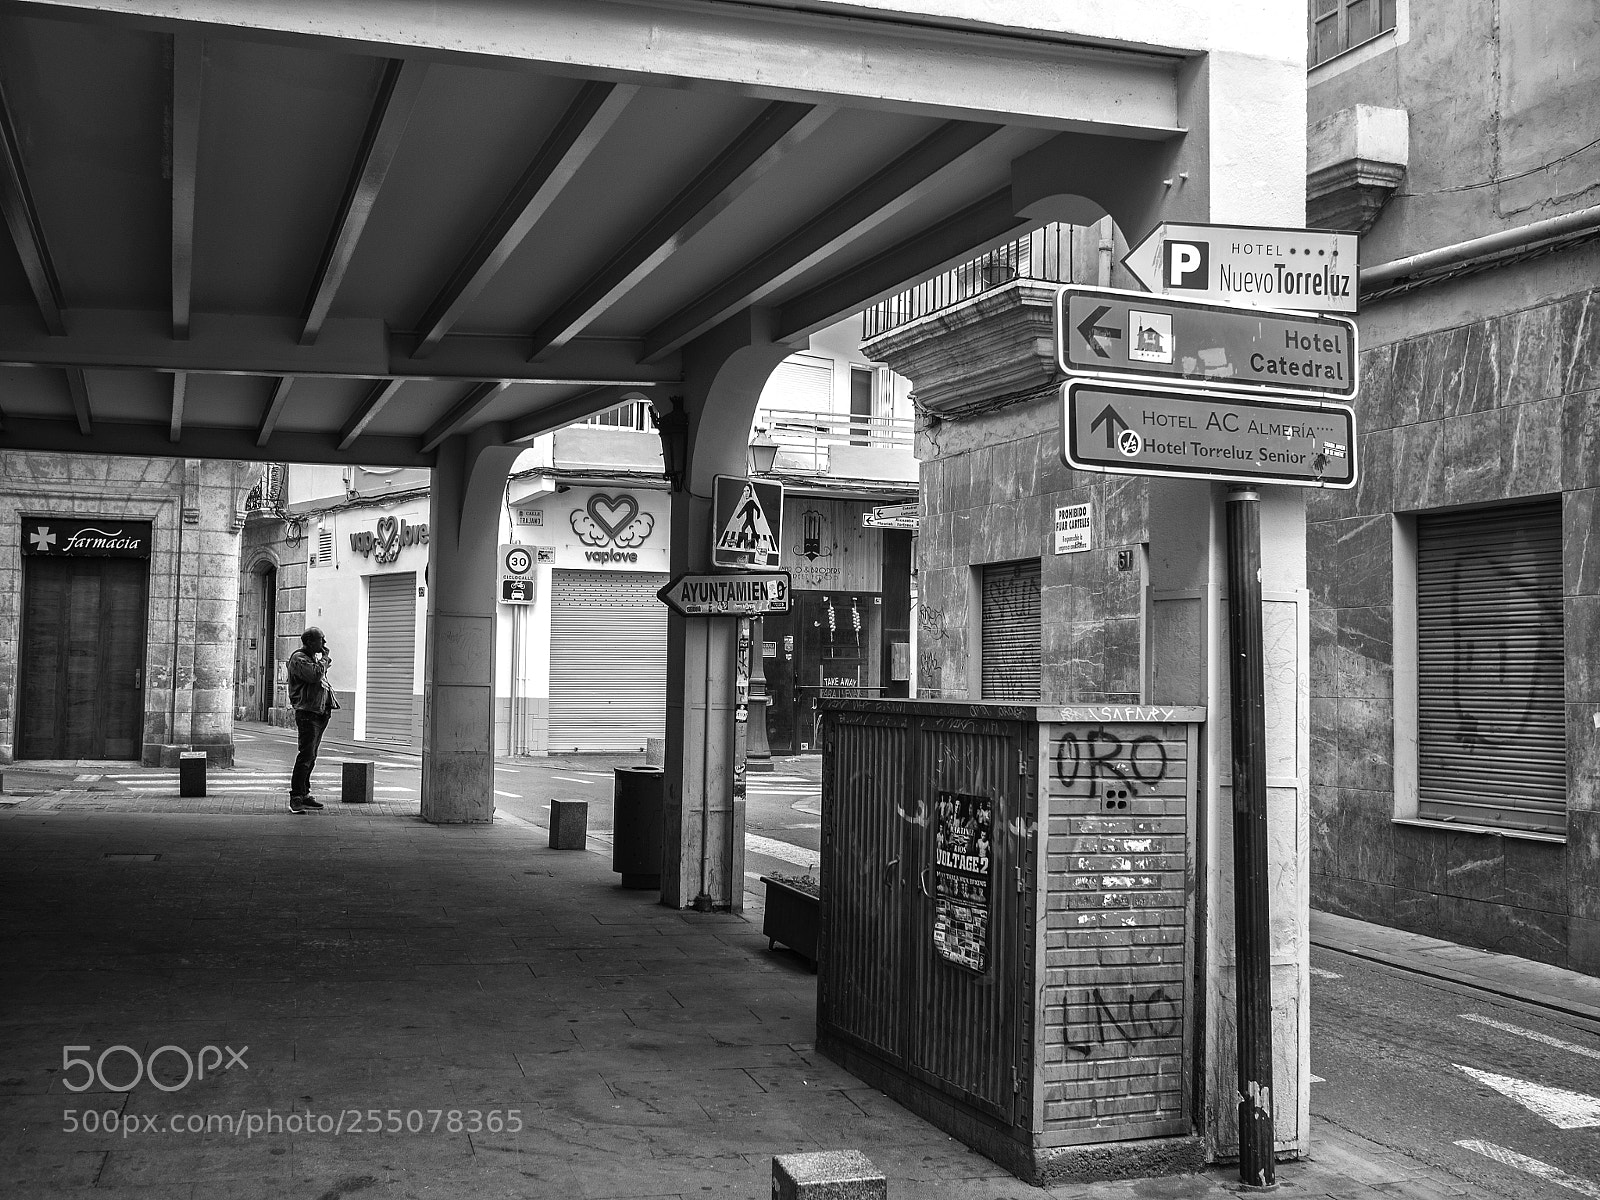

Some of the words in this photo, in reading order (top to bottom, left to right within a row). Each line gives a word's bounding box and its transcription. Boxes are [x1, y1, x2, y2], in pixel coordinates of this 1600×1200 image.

[1231, 243, 1283, 257] HOTEL
[1171, 243, 1201, 286] P
[1284, 329, 1342, 354] Hotel
[1249, 352, 1343, 381] Catedral
[1142, 410, 1197, 430] HOTEL
[1205, 411, 1240, 433] AC
[1142, 437, 1187, 456] Hotel
[1189, 441, 1254, 461] Torreluz
[1258, 447, 1306, 465] Senior
[62, 527, 141, 552] farmacia
[511, 557, 526, 567] 30
[585, 548, 637, 565] vaplove
[1119, 551, 1131, 569] 61
[681, 581, 787, 602] AYUNTAMIENO
[824, 678, 839, 686] TAKE
[936, 848, 979, 873] VOLTAGE
[980, 857, 989, 874] 2
